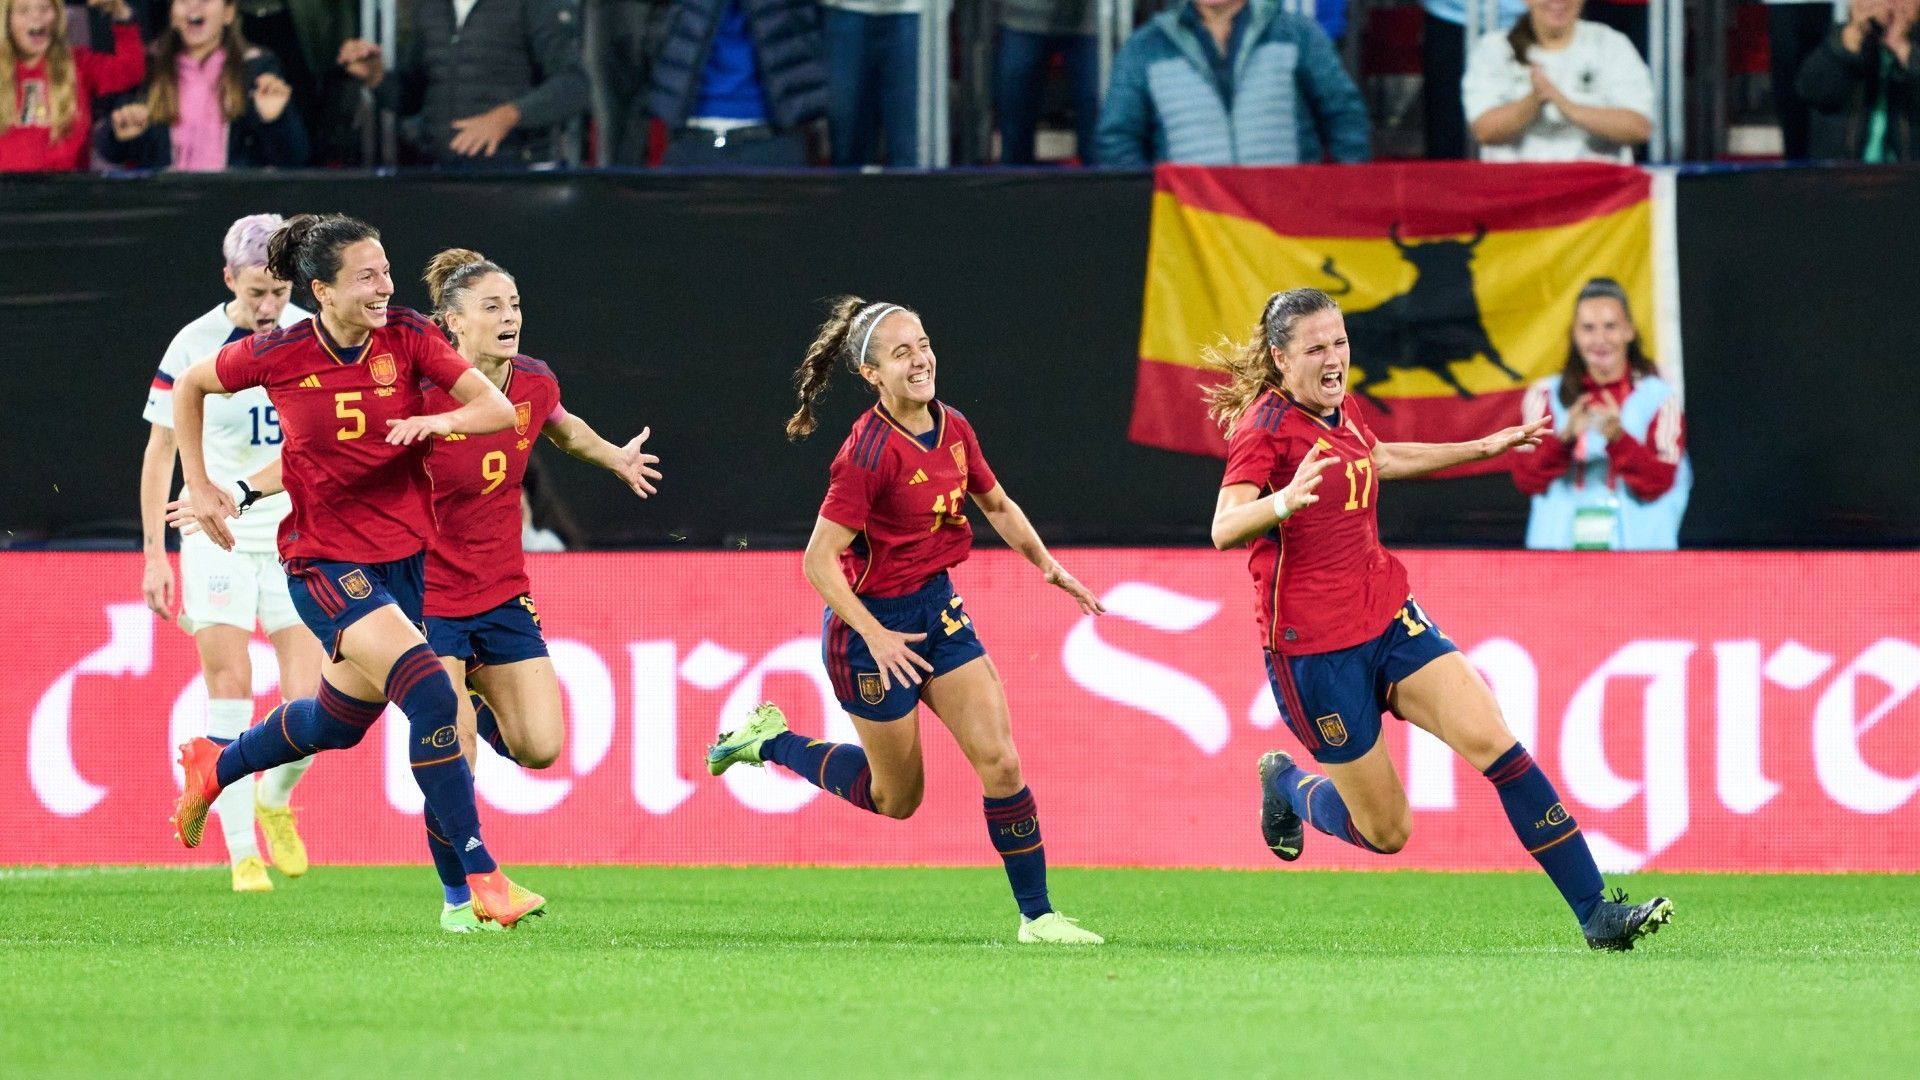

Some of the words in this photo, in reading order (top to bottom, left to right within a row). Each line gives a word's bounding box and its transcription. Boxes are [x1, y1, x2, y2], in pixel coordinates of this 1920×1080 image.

[248, 406, 285, 446] 15
[335, 391, 366, 441] 5
[481, 450, 507, 495] 9
[1344, 457, 1373, 511] 17
